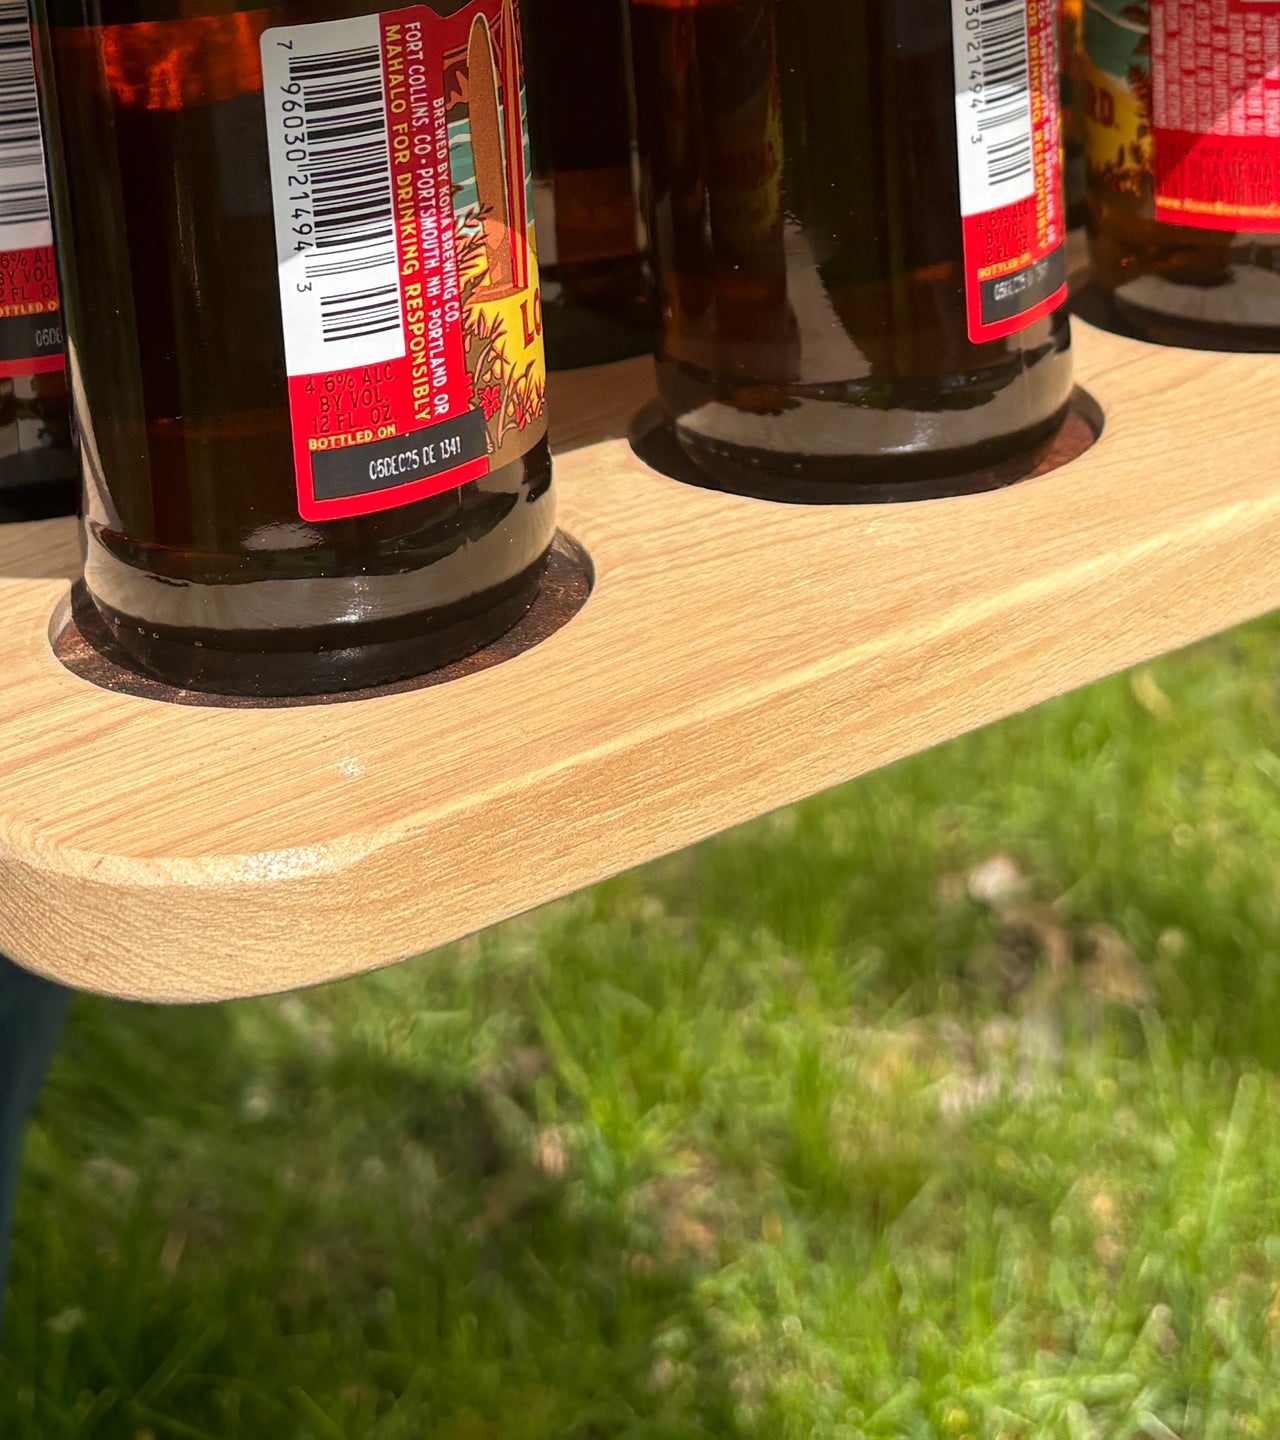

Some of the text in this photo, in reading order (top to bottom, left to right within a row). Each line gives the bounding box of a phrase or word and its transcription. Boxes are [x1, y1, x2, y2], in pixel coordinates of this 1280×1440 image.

[404, 21, 424, 60] FORT
[967, 41, 983, 108] 21494
[408, 65, 429, 131] COLLINS,
[414, 134, 432, 155] CO
[432, 96, 448, 159] BREWED
[971, 134, 982, 144] 3
[277, 40, 313, 293] 7 96030 21494 3
[437, 161, 449, 181] BY
[385, 24, 431, 420] MAHALO FOR DRINKING RESPONSIBLY
[416, 167, 440, 274] PORTSMOUTH,
[438, 185, 452, 229] KONA
[441, 230, 458, 300] BREWING
[426, 275, 441, 297] NH
[305, 363, 399, 394] 4.6% ALC.
[320, 388, 390, 413] BY VOL.
[433, 393, 450, 415] OR
[308, 424, 396, 450] BOTTLED ON
[313, 406, 398, 434] 12 FL. OZ.
